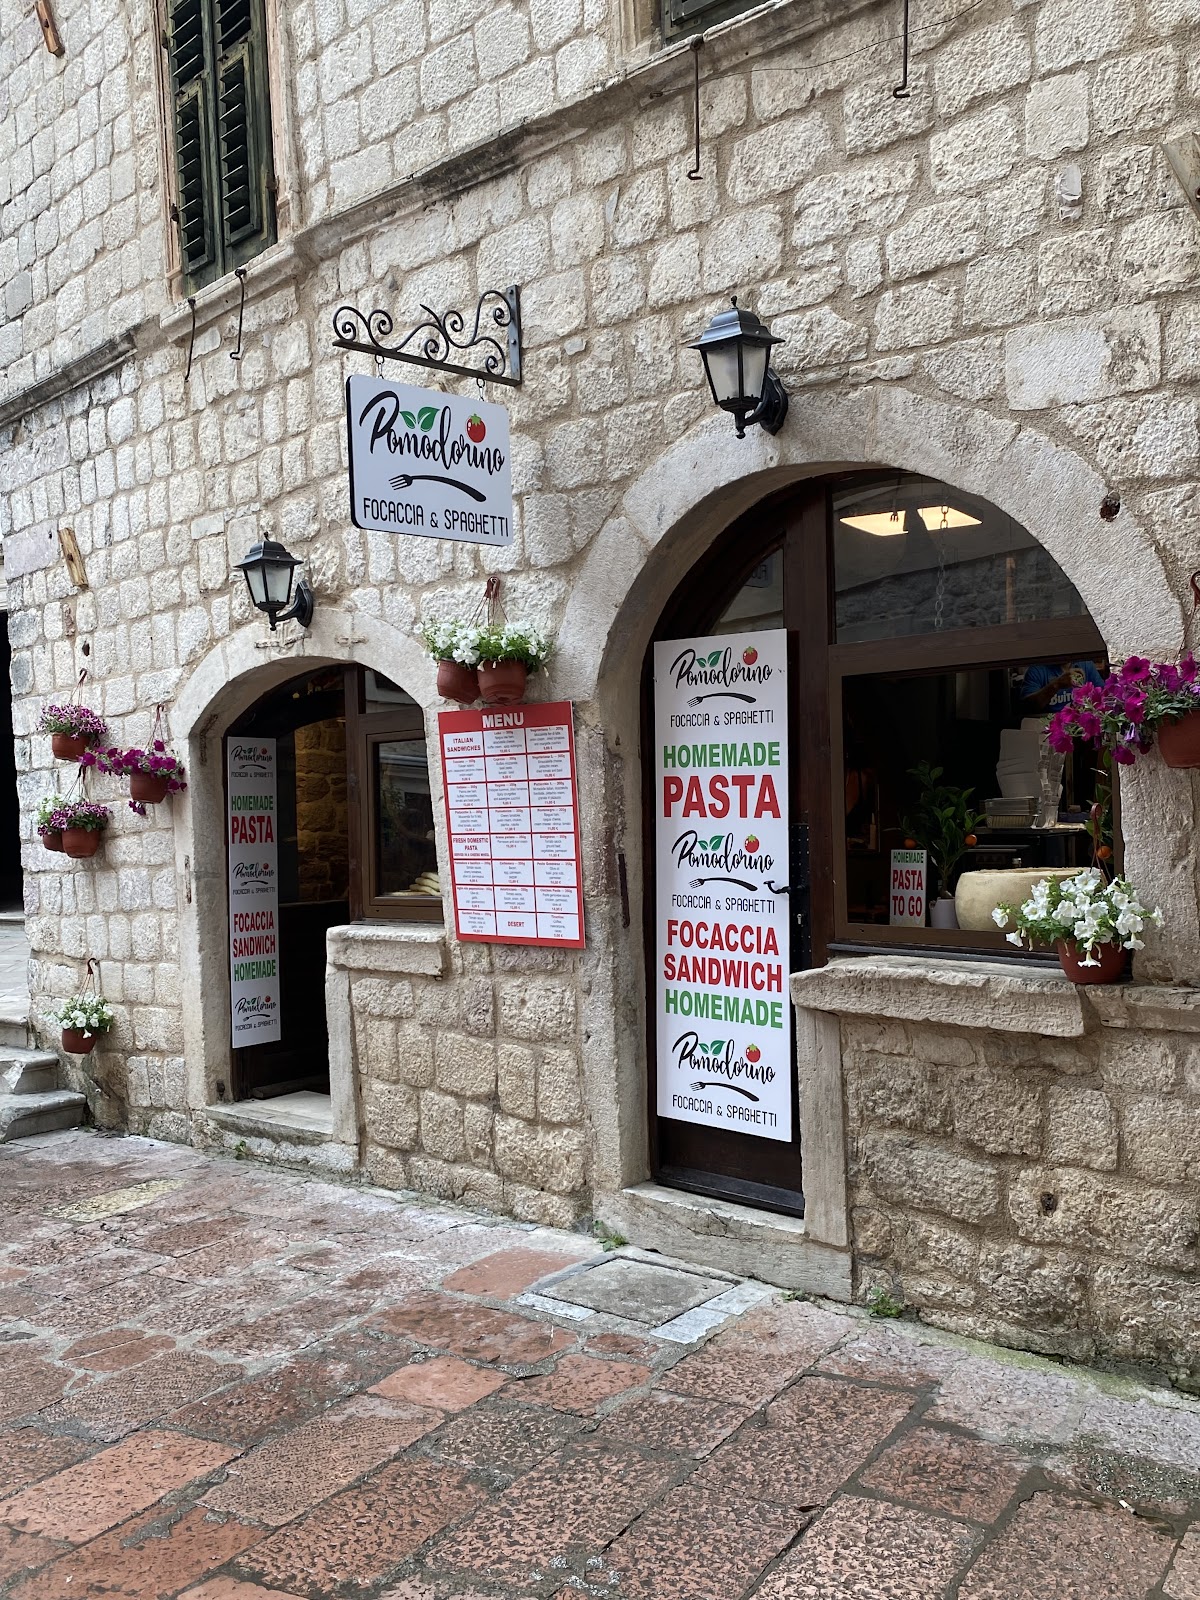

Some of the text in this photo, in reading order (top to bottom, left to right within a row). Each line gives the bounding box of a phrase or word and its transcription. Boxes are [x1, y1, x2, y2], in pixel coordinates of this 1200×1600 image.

[359, 390, 505, 476] Pomodorino
[363, 497, 509, 537] FOCACCIA & SPAGHETTI
[669, 646, 773, 689] Pomodorino
[482, 712, 524, 729] MENU
[670, 709, 774, 728] FOCACCIA & SPAGHETTI
[231, 745, 273, 763] Pomodorino
[663, 741, 781, 769] HOMEMADE
[231, 795, 274, 811] HOMEMADE
[663, 774, 781, 819] PASTA
[231, 815, 274, 844] PASTA
[671, 829, 775, 873] Pomodorino
[893, 852, 924, 863] HOMEMADE
[232, 862, 275, 879] Pomodorino
[892, 869, 924, 891] PASTA
[672, 894, 775, 914] FOCACCIA & SPAGHETTI
[892, 895, 923, 917] TO GO
[233, 910, 274, 933] FOCACCIA
[233, 934, 276, 958] SANDWICH
[667, 919, 779, 956] FOCACCIA
[234, 959, 276, 982] HOMEMADE
[664, 953, 782, 993] SANDWICH
[234, 995, 277, 1015] Pomodorino
[665, 988, 783, 1029] HOMEMADE
[672, 1031, 776, 1085] Pomodorino
[672, 1094, 777, 1127] FOCACCIA & SPAGHETTI
